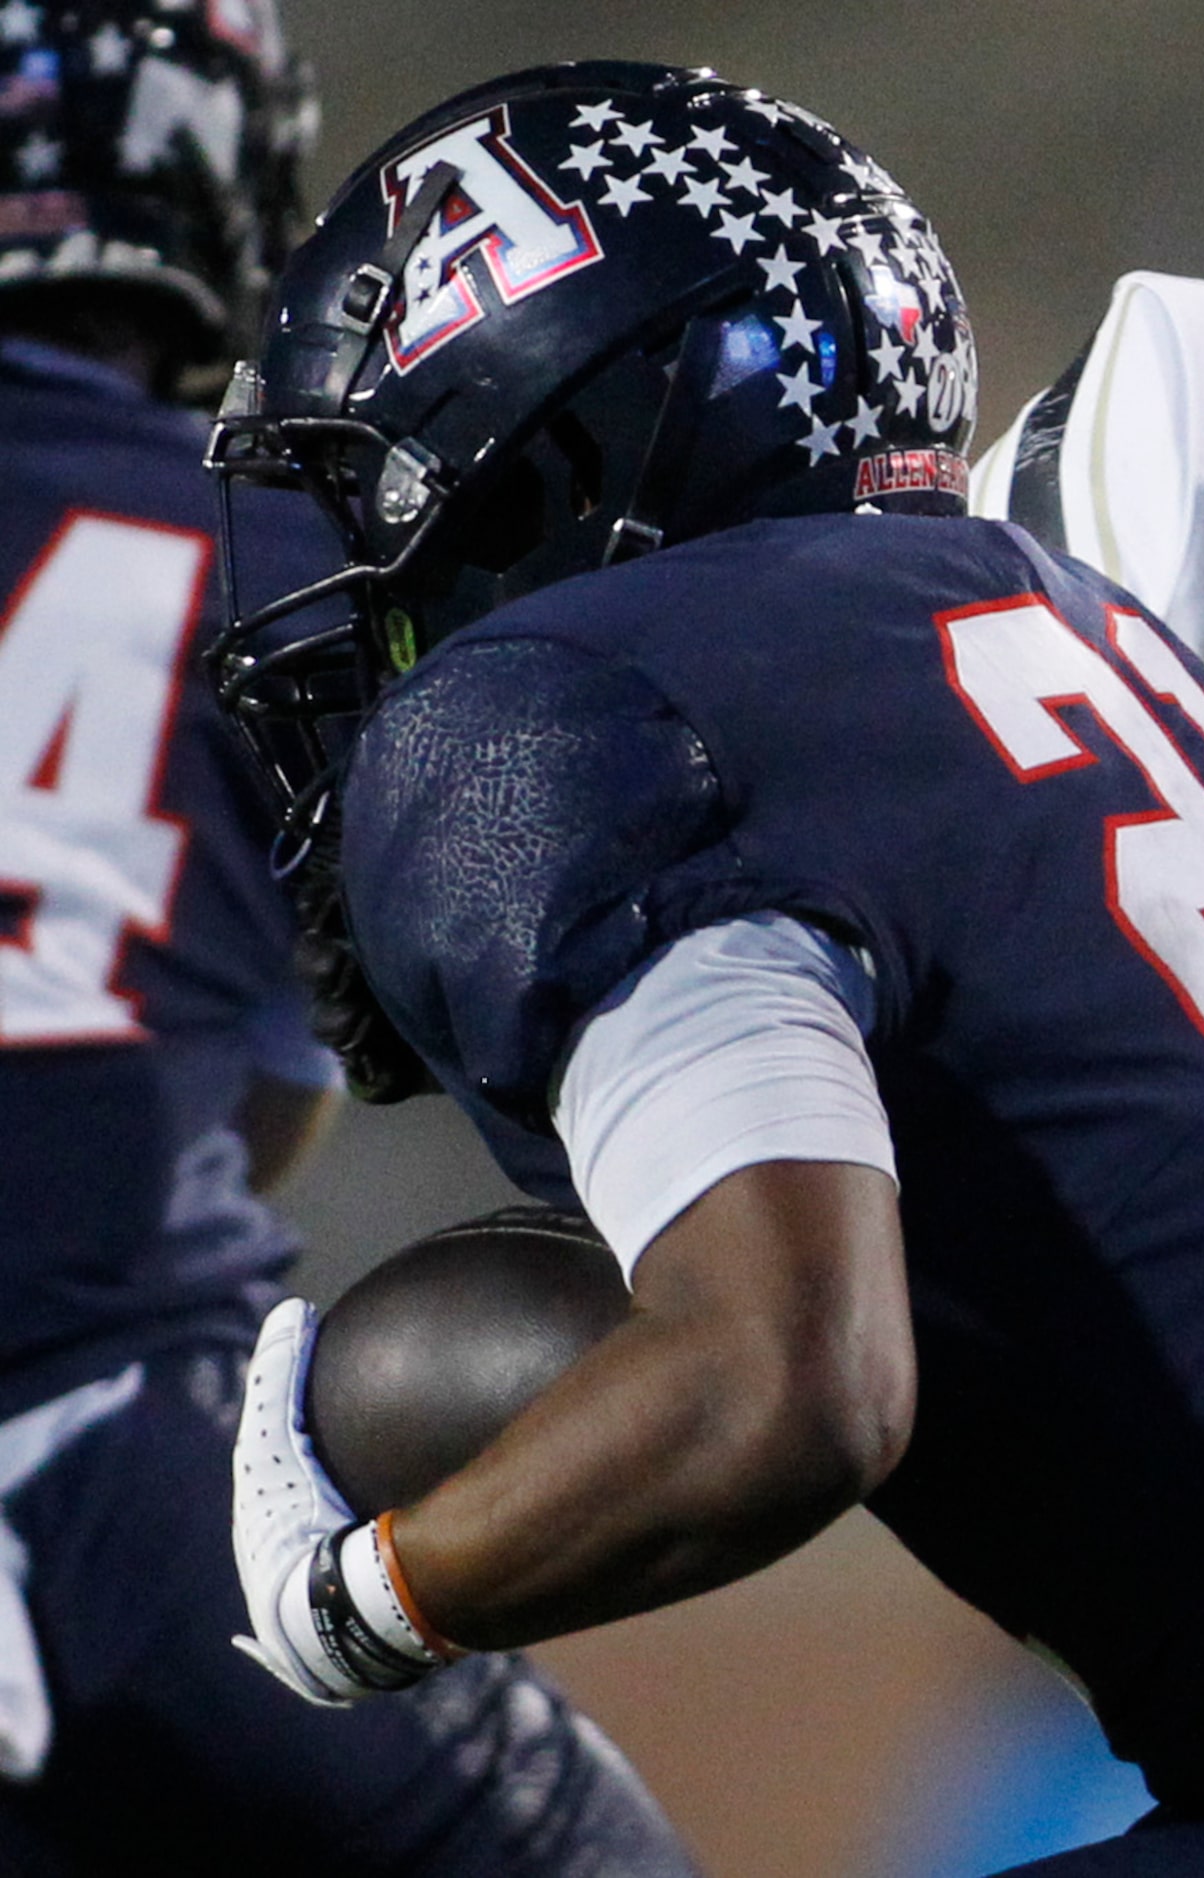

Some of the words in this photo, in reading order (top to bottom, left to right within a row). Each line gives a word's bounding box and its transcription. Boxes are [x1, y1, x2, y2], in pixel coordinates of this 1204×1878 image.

[380, 104, 604, 376] A
[932, 362, 956, 422] 21
[854, 449, 936, 500] ALLEN
